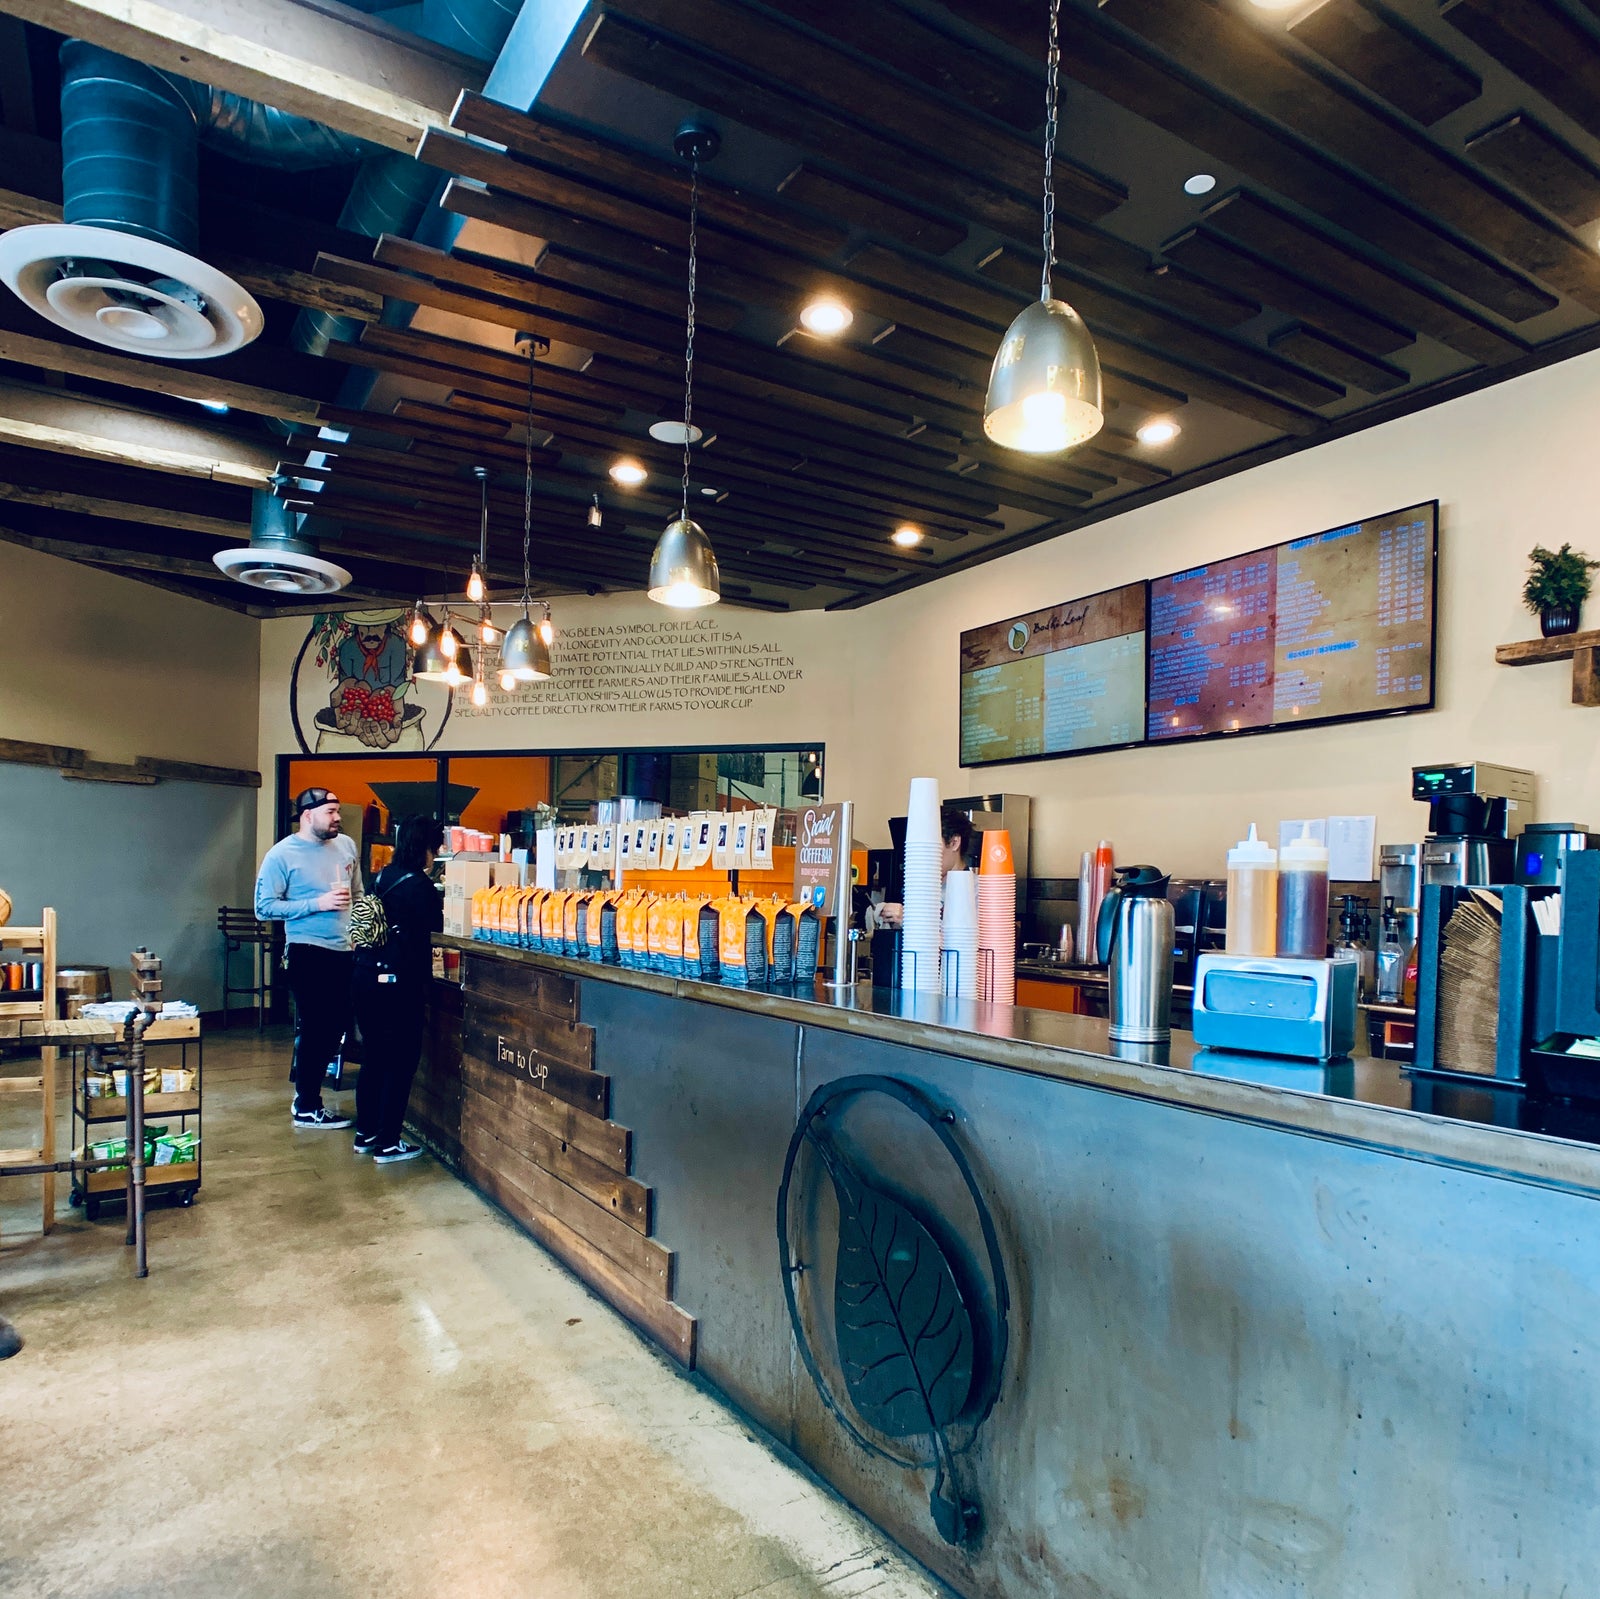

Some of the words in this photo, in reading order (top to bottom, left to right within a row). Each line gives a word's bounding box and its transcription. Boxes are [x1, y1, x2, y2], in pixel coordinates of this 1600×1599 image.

[577, 626, 605, 638] BEEN
[606, 626, 616, 635] A
[616, 623, 658, 634] SYMBOL
[660, 622, 678, 632] FOR
[566, 639, 621, 650] LONGEVITY
[623, 637, 644, 647] AND
[646, 635, 678, 645] GOOD
[710, 632, 720, 642] IT
[722, 632, 733, 641] IS
[734, 632, 742, 640] A
[550, 652, 590, 664] LTIMATE
[592, 650, 648, 661] POTENTIAL
[651, 648, 678, 658] THAT
[681, 647, 704, 658] LIES
[706, 645, 742, 656] WITHIN
[743, 644, 760, 654] US
[760, 643, 782, 652] ALL
[579, 666, 592, 676] TO
[594, 664, 662, 676] CONTINUALLY
[664, 662, 694, 672] BUILD
[695, 660, 718, 670] AND
[720, 657, 794, 670] STRENGTHEN
[532, 681, 556, 691] WITH
[556, 678, 594, 690] COFFEE
[598, 677, 645, 688] FARMERS
[646, 676, 668, 686] AND
[670, 674, 701, 684] THEIR
[702, 672, 750, 683] FAMILIES
[751, 671, 772, 681] ALL
[772, 670, 803, 680] OVER
[512, 694, 544, 704] THESE
[546, 690, 620, 702] RELATIONSHIPS
[622, 690, 654, 700] ALLOW
[656, 688, 672, 698] US
[674, 688, 688, 698] TO
[690, 686, 732, 696] PROVIDE
[734, 685, 760, 695] HIGH
[762, 684, 786, 694] END
[455, 706, 502, 718] SPECIALTY
[504, 705, 541, 716] COFFEE
[542, 704, 591, 714] DIRECTLY
[590, 704, 617, 713] FROM
[619, 702, 647, 712] THEIR
[650, 702, 682, 712] FARMS
[684, 701, 700, 710] TO
[700, 700, 730, 710] YOUR
[802, 810, 836, 847] Social
[800, 848, 822, 864] COFFEE
[498, 1036, 514, 1064] Farm
[517, 1050, 526, 1069] to
[529, 1049, 548, 1090] Cup
